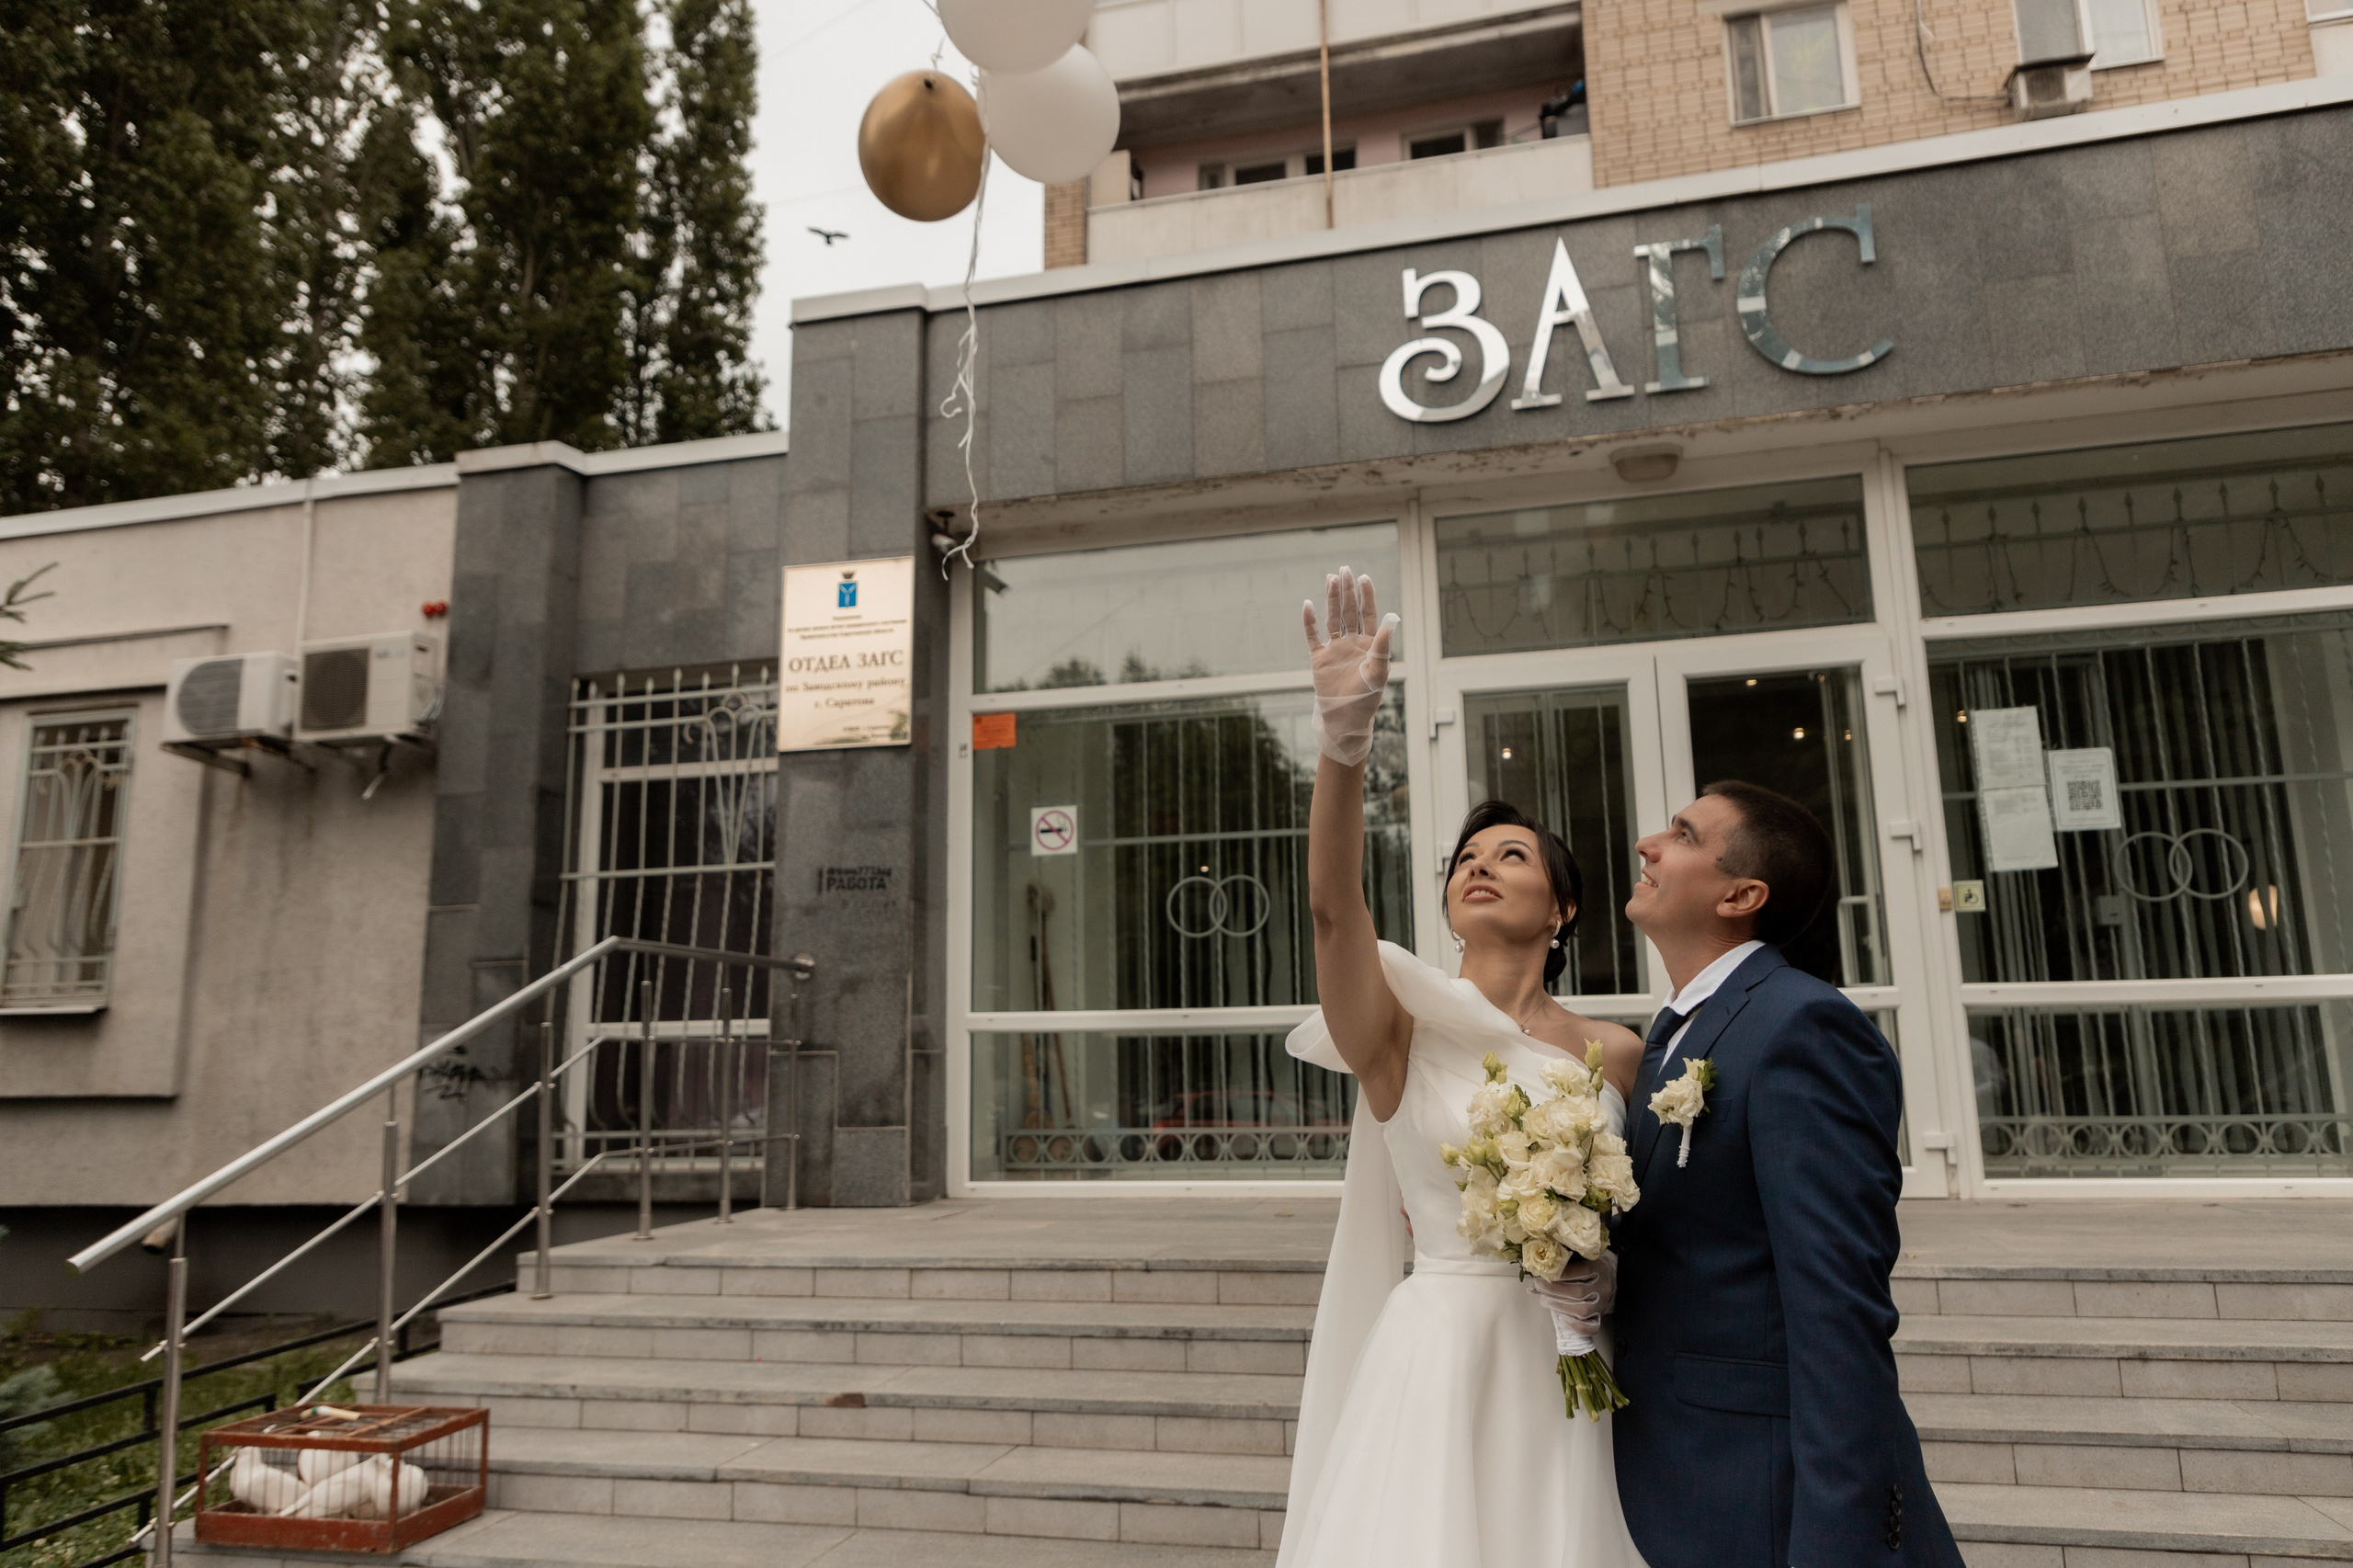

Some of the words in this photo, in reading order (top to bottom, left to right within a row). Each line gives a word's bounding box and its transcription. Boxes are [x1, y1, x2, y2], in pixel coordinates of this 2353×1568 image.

[1378, 201, 1894, 423] ЗАГС
[789, 654, 850, 674] ОТДЕЛ
[858, 649, 904, 668] ЗАГС
[867, 677, 904, 689] району
